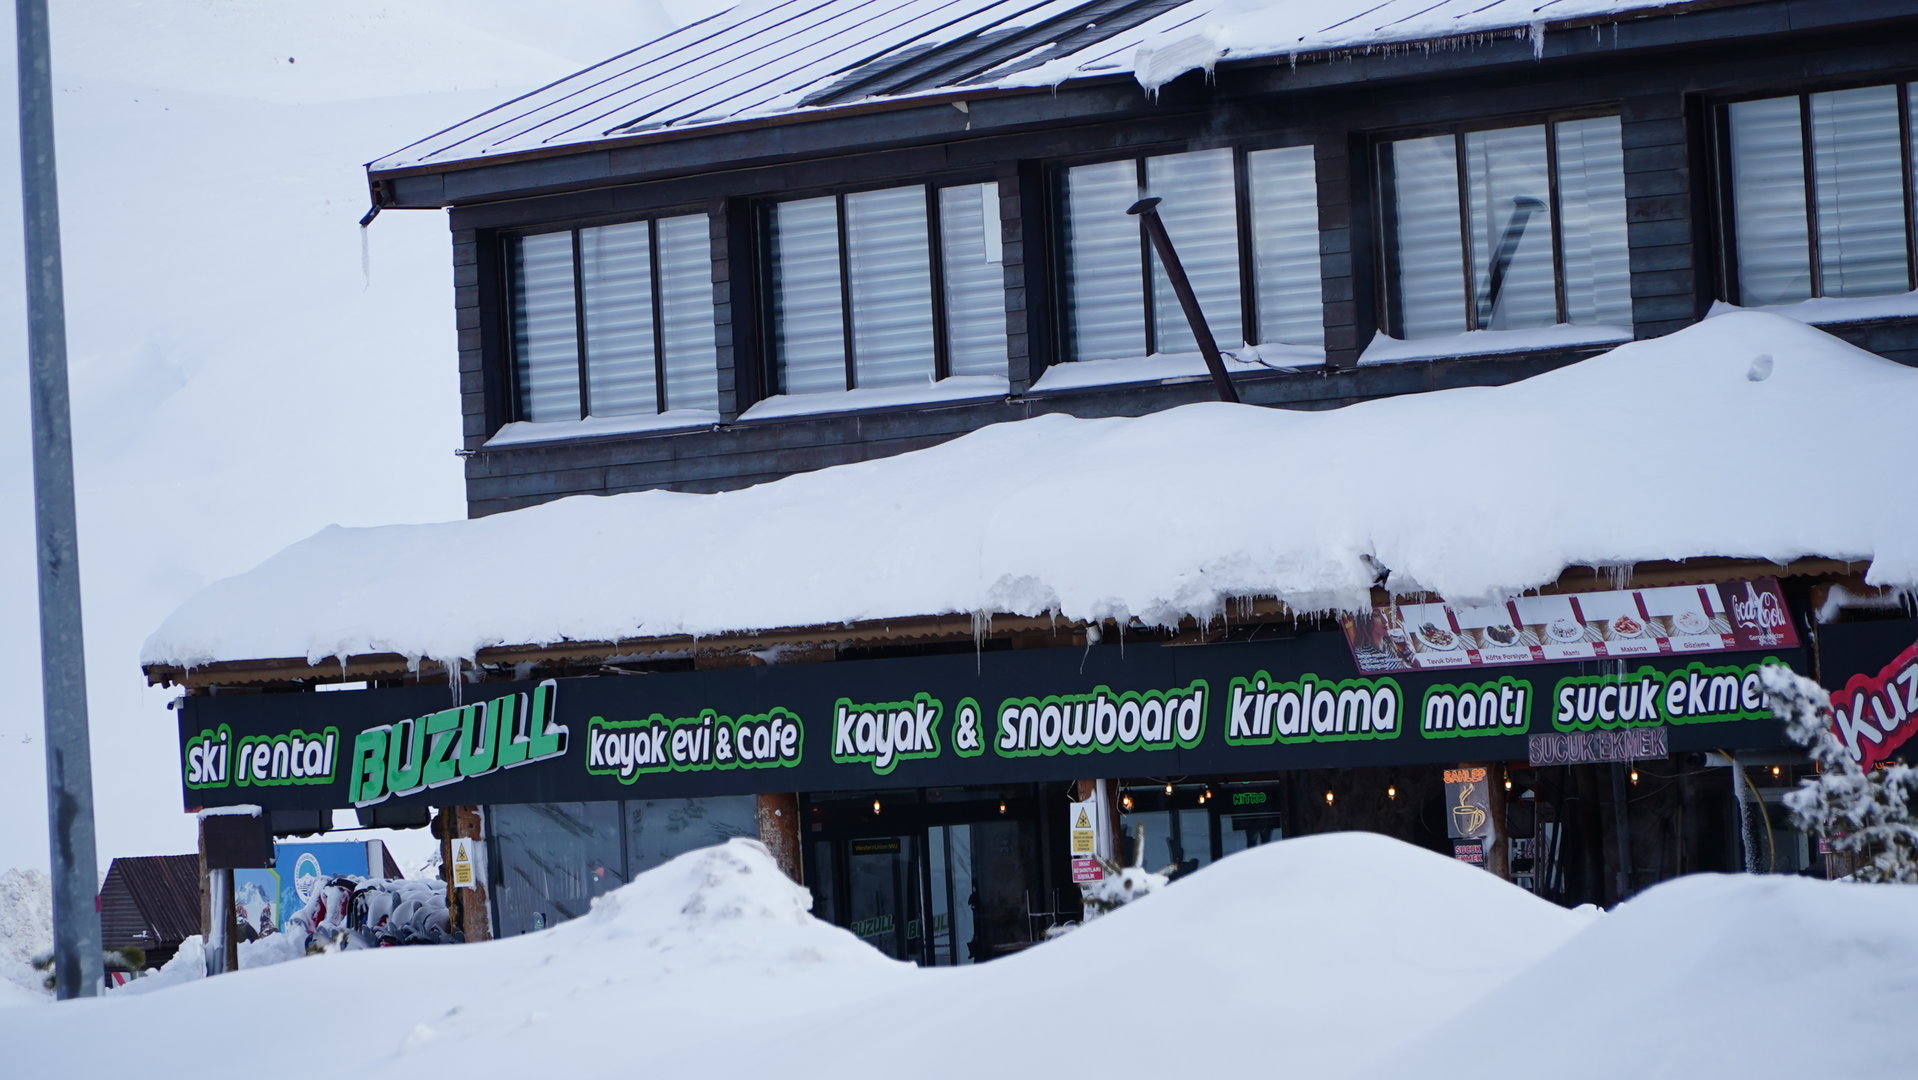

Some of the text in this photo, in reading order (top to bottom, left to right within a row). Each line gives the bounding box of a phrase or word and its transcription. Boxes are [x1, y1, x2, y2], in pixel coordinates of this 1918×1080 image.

[835, 680, 1397, 767] kayak & snowboard kiralama
[1558, 672, 1772, 723] sucuk ekme
[187, 730, 335, 784] ski rental
[349, 681, 568, 806] BUZULL
[590, 717, 798, 777] kayak evi & cafe
[1529, 728, 1668, 764] SUCUK EKMEK
[1455, 844, 1482, 854] SUCUK
